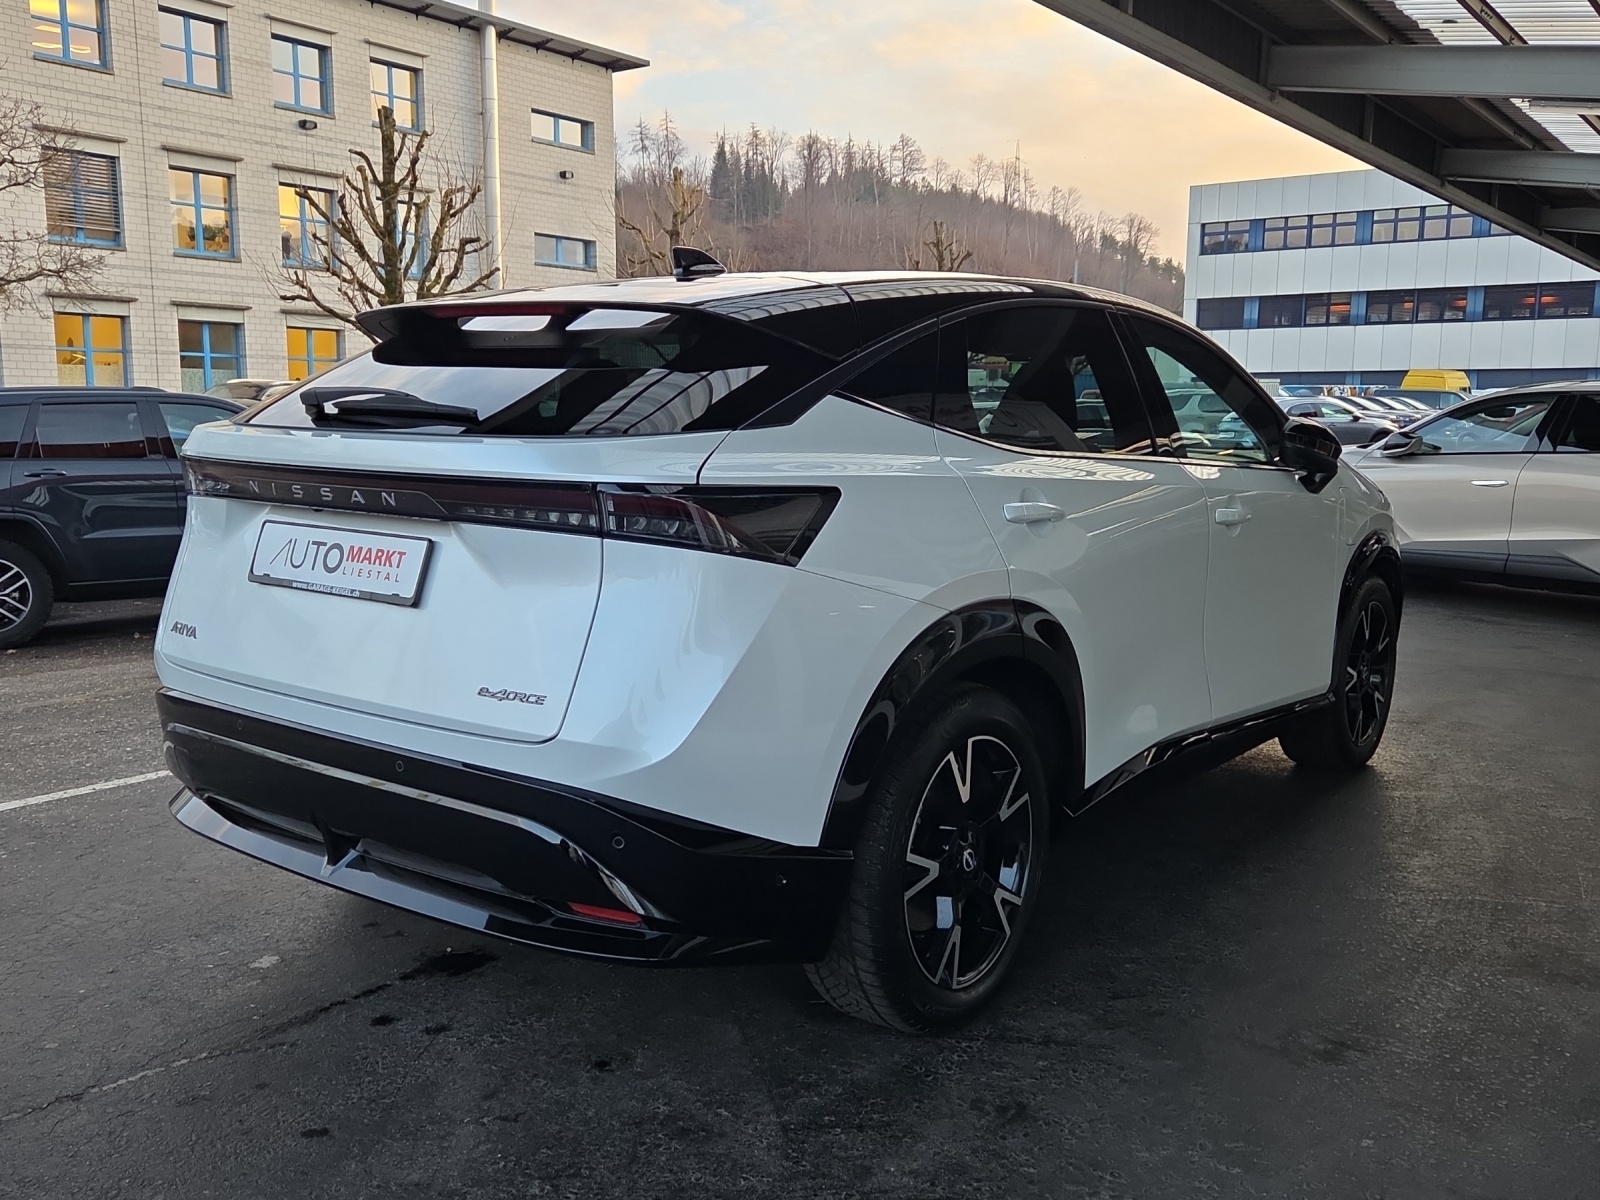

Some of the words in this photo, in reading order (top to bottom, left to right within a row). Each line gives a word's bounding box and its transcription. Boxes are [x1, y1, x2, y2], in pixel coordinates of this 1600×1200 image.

[248, 480, 397, 506] NISSAN
[270, 538, 344, 574] AUTO
[346, 545, 407, 569] MARKT
[342, 567, 400, 583] LIESTAL
[170, 621, 197, 639] ARIYA
